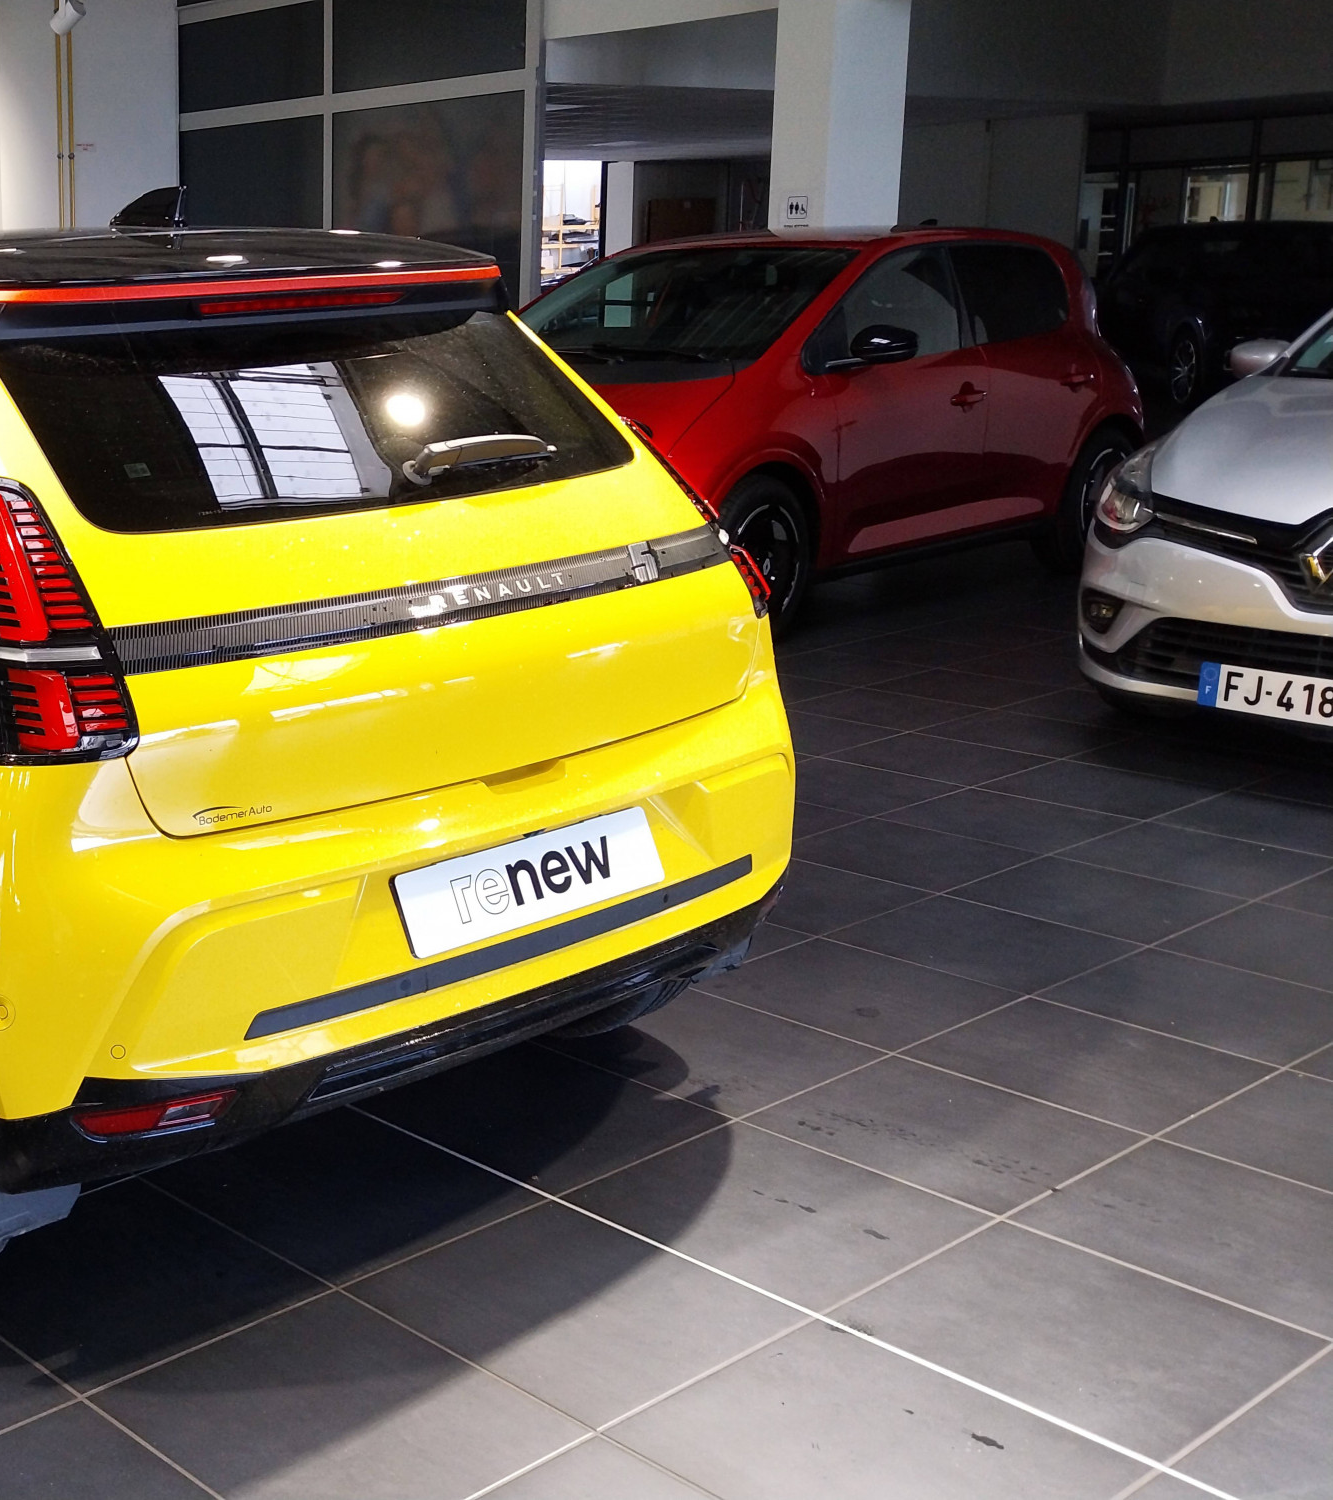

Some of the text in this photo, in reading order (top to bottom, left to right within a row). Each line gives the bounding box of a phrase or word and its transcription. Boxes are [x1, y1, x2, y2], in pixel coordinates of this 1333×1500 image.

[428, 572, 565, 609] RENAULT
[1205, 685, 1212, 694] F
[450, 835, 611, 924] renew
